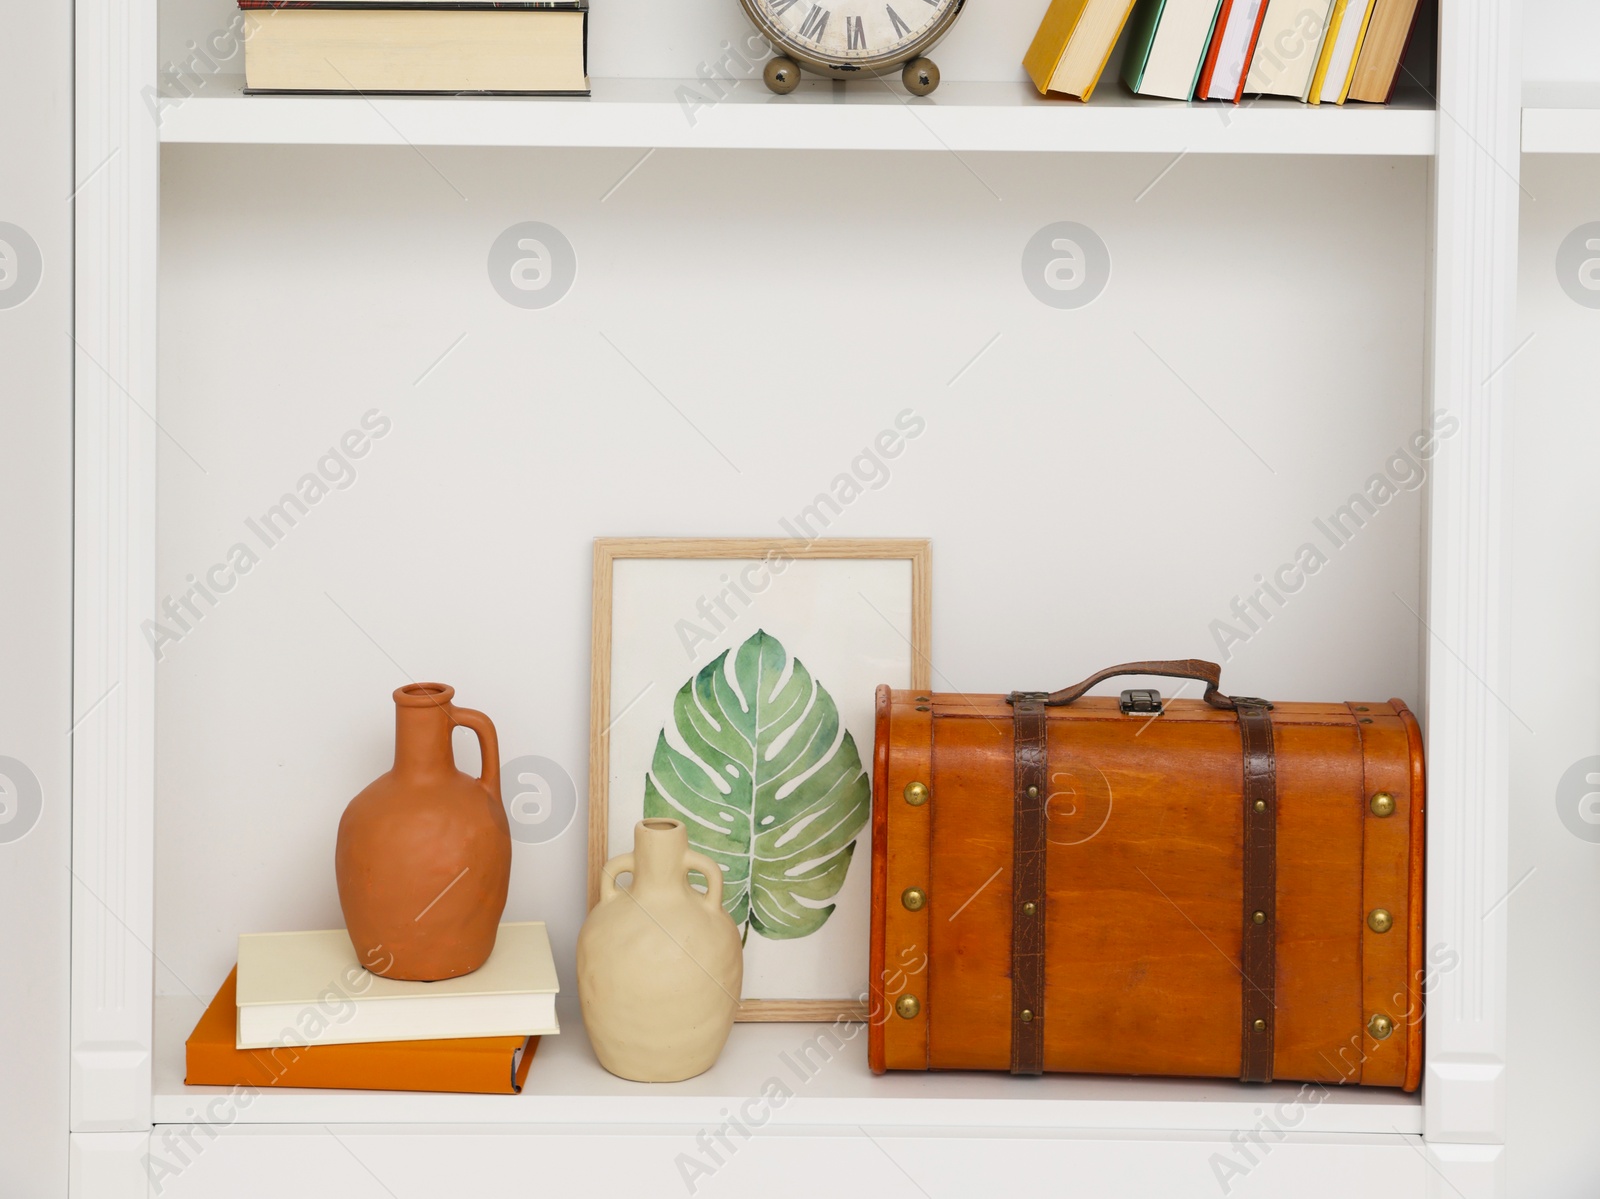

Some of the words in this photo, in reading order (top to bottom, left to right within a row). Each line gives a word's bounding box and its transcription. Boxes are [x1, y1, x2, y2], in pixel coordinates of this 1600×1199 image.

[799, 3, 830, 44] VII
[846, 15, 867, 50] VI
[886, 3, 912, 38] V
